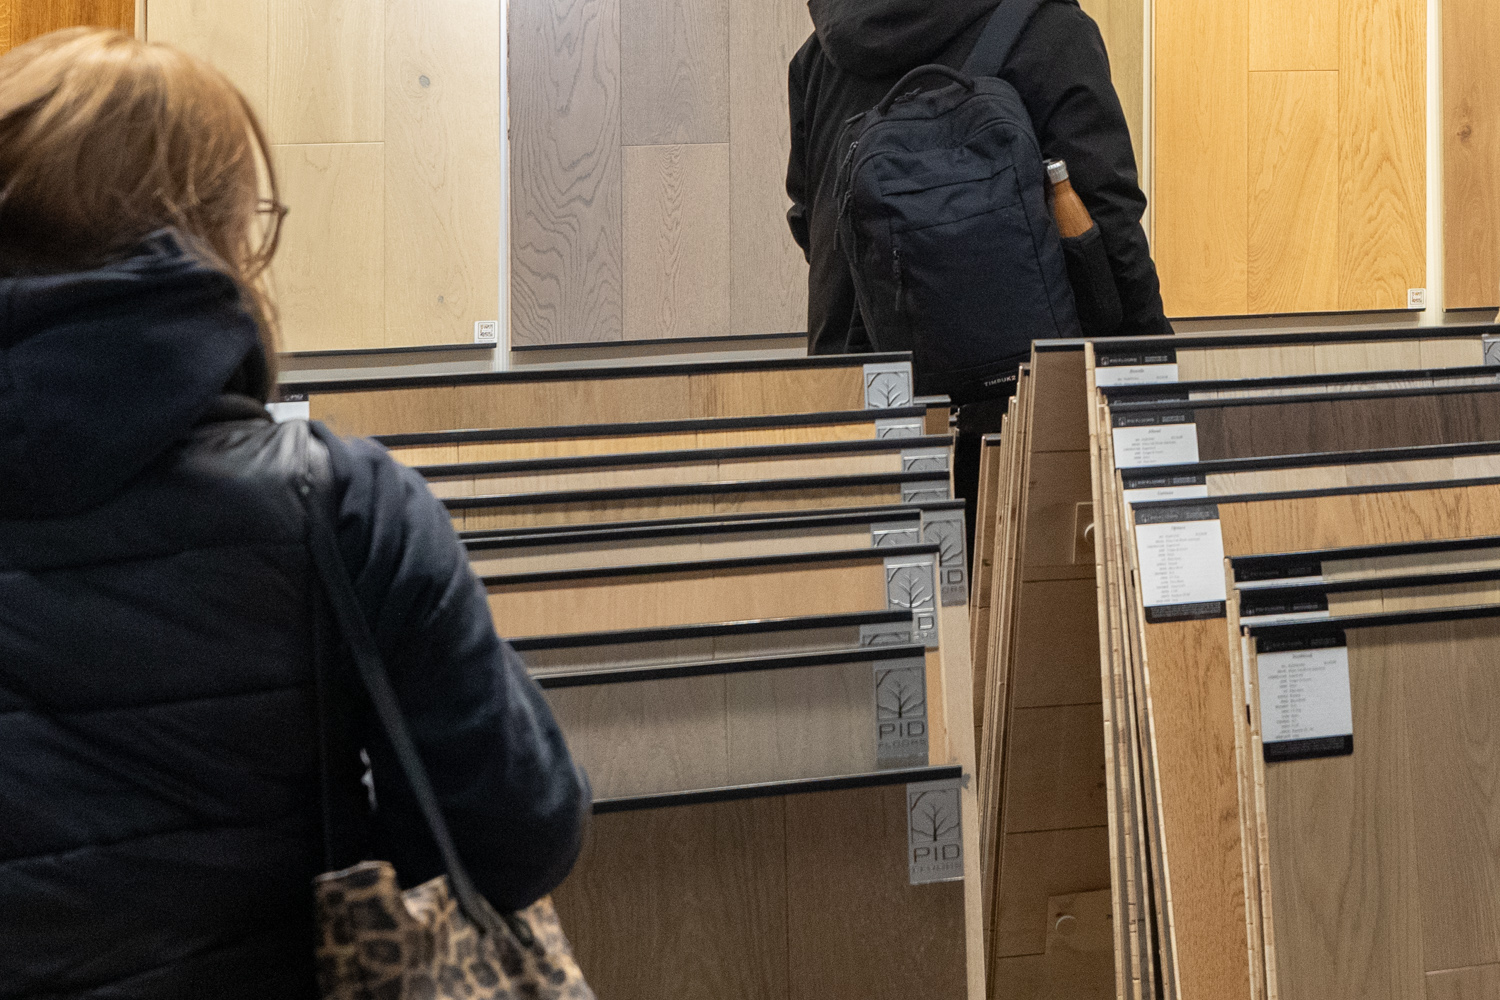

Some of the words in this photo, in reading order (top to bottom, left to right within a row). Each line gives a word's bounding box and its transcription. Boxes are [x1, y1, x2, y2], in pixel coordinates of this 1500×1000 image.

[984, 375, 1016, 386] TIMBUK2
[940, 569, 963, 584] ID
[879, 720, 924, 740] PID
[914, 844, 960, 862] PID
